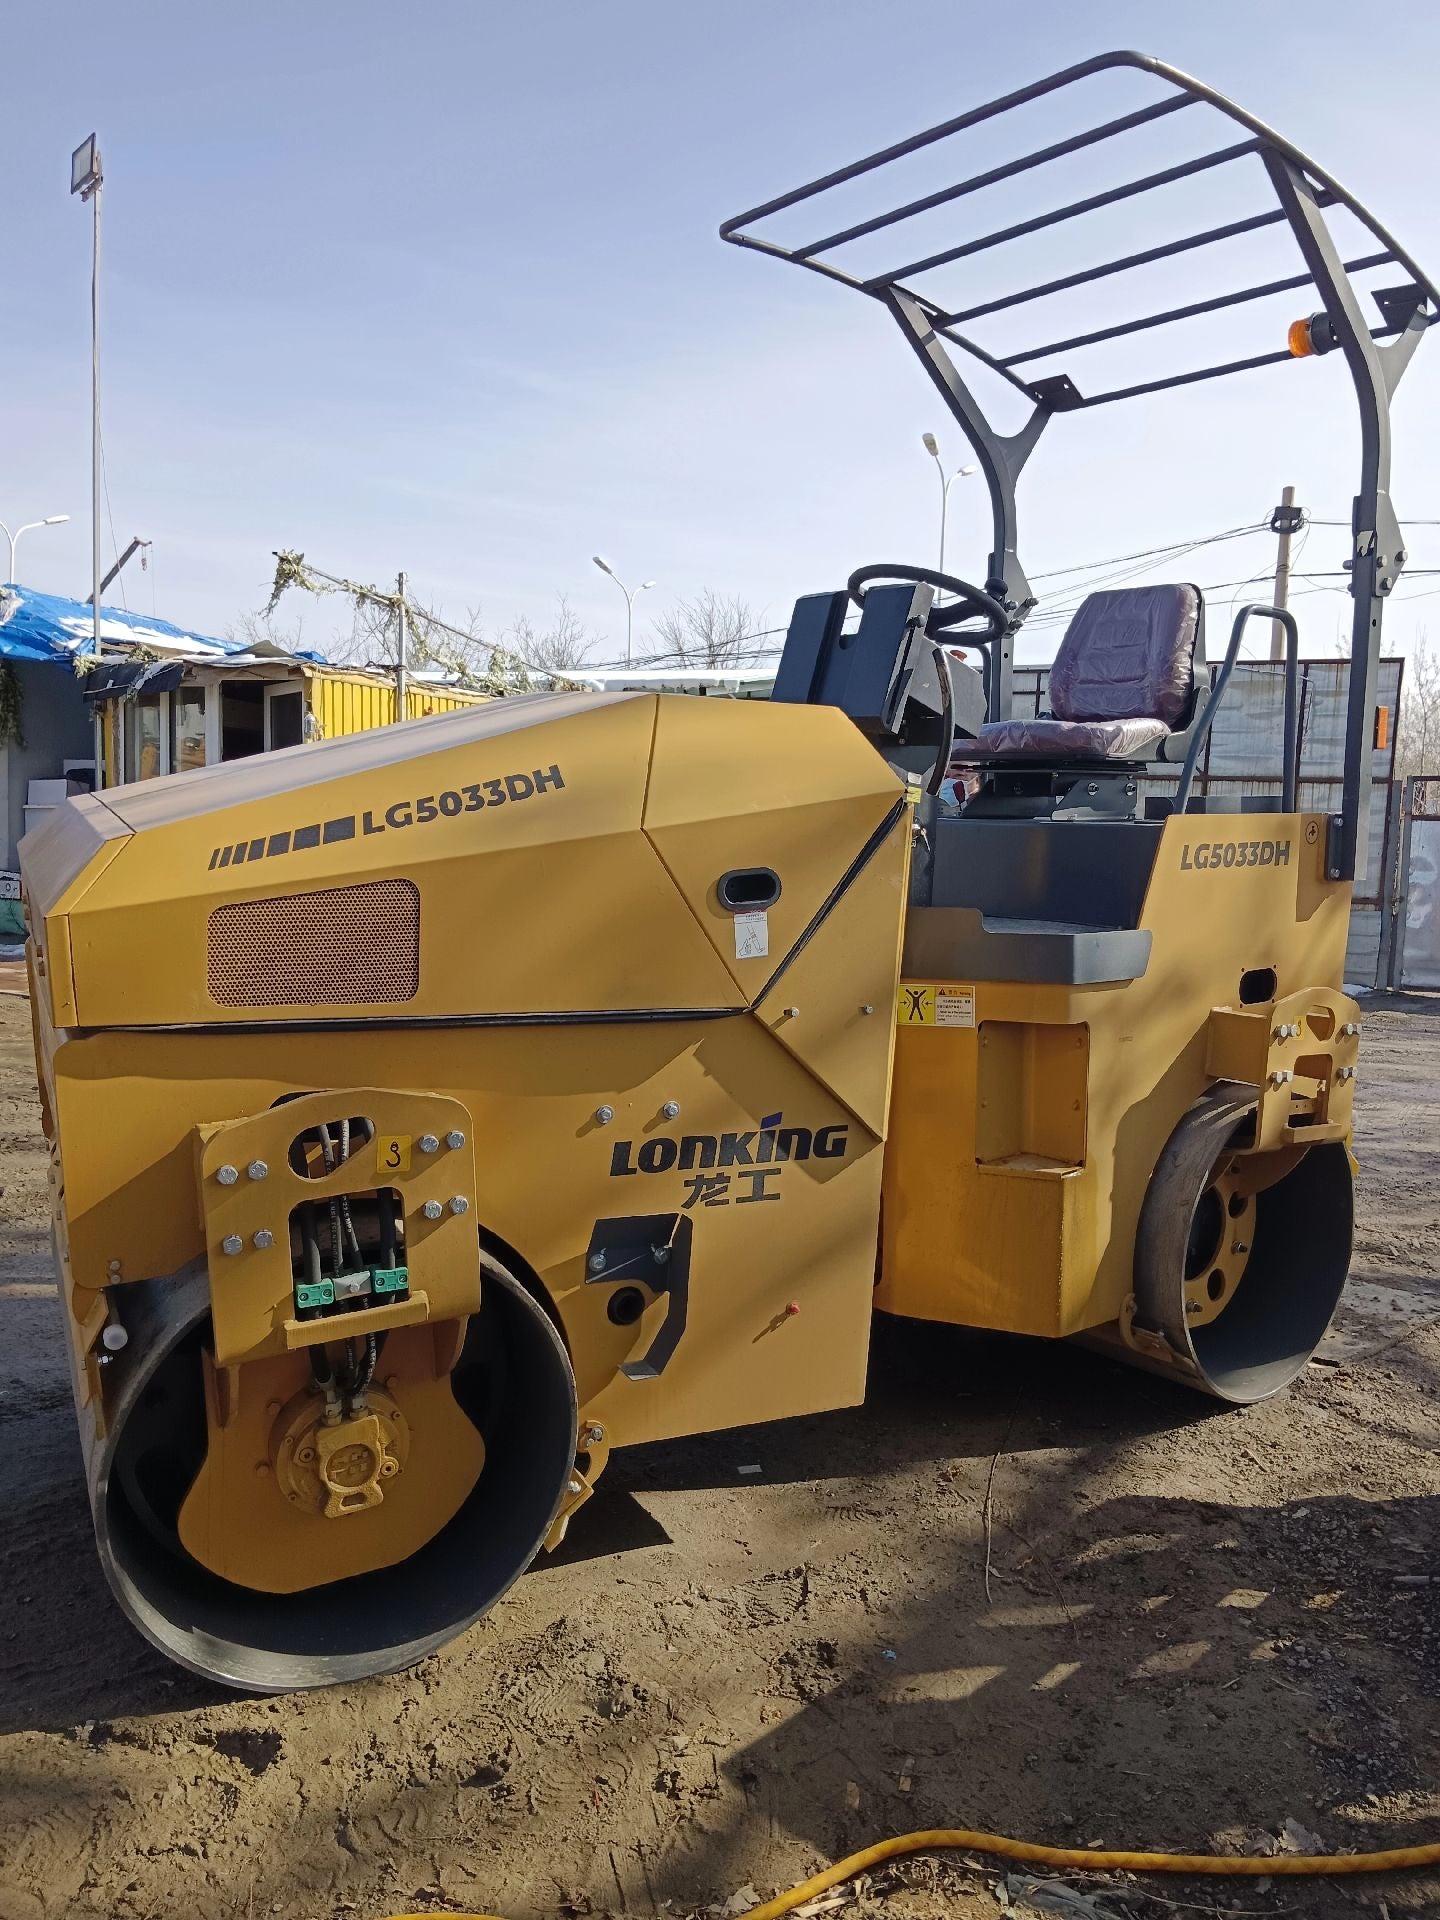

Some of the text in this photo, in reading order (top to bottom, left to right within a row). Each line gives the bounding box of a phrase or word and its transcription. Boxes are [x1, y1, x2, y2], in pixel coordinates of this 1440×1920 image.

[362, 764, 566, 836] LG5033DH
[1180, 840, 1291, 871] LG5033DH
[681, 1168, 782, 1210] 龙工
